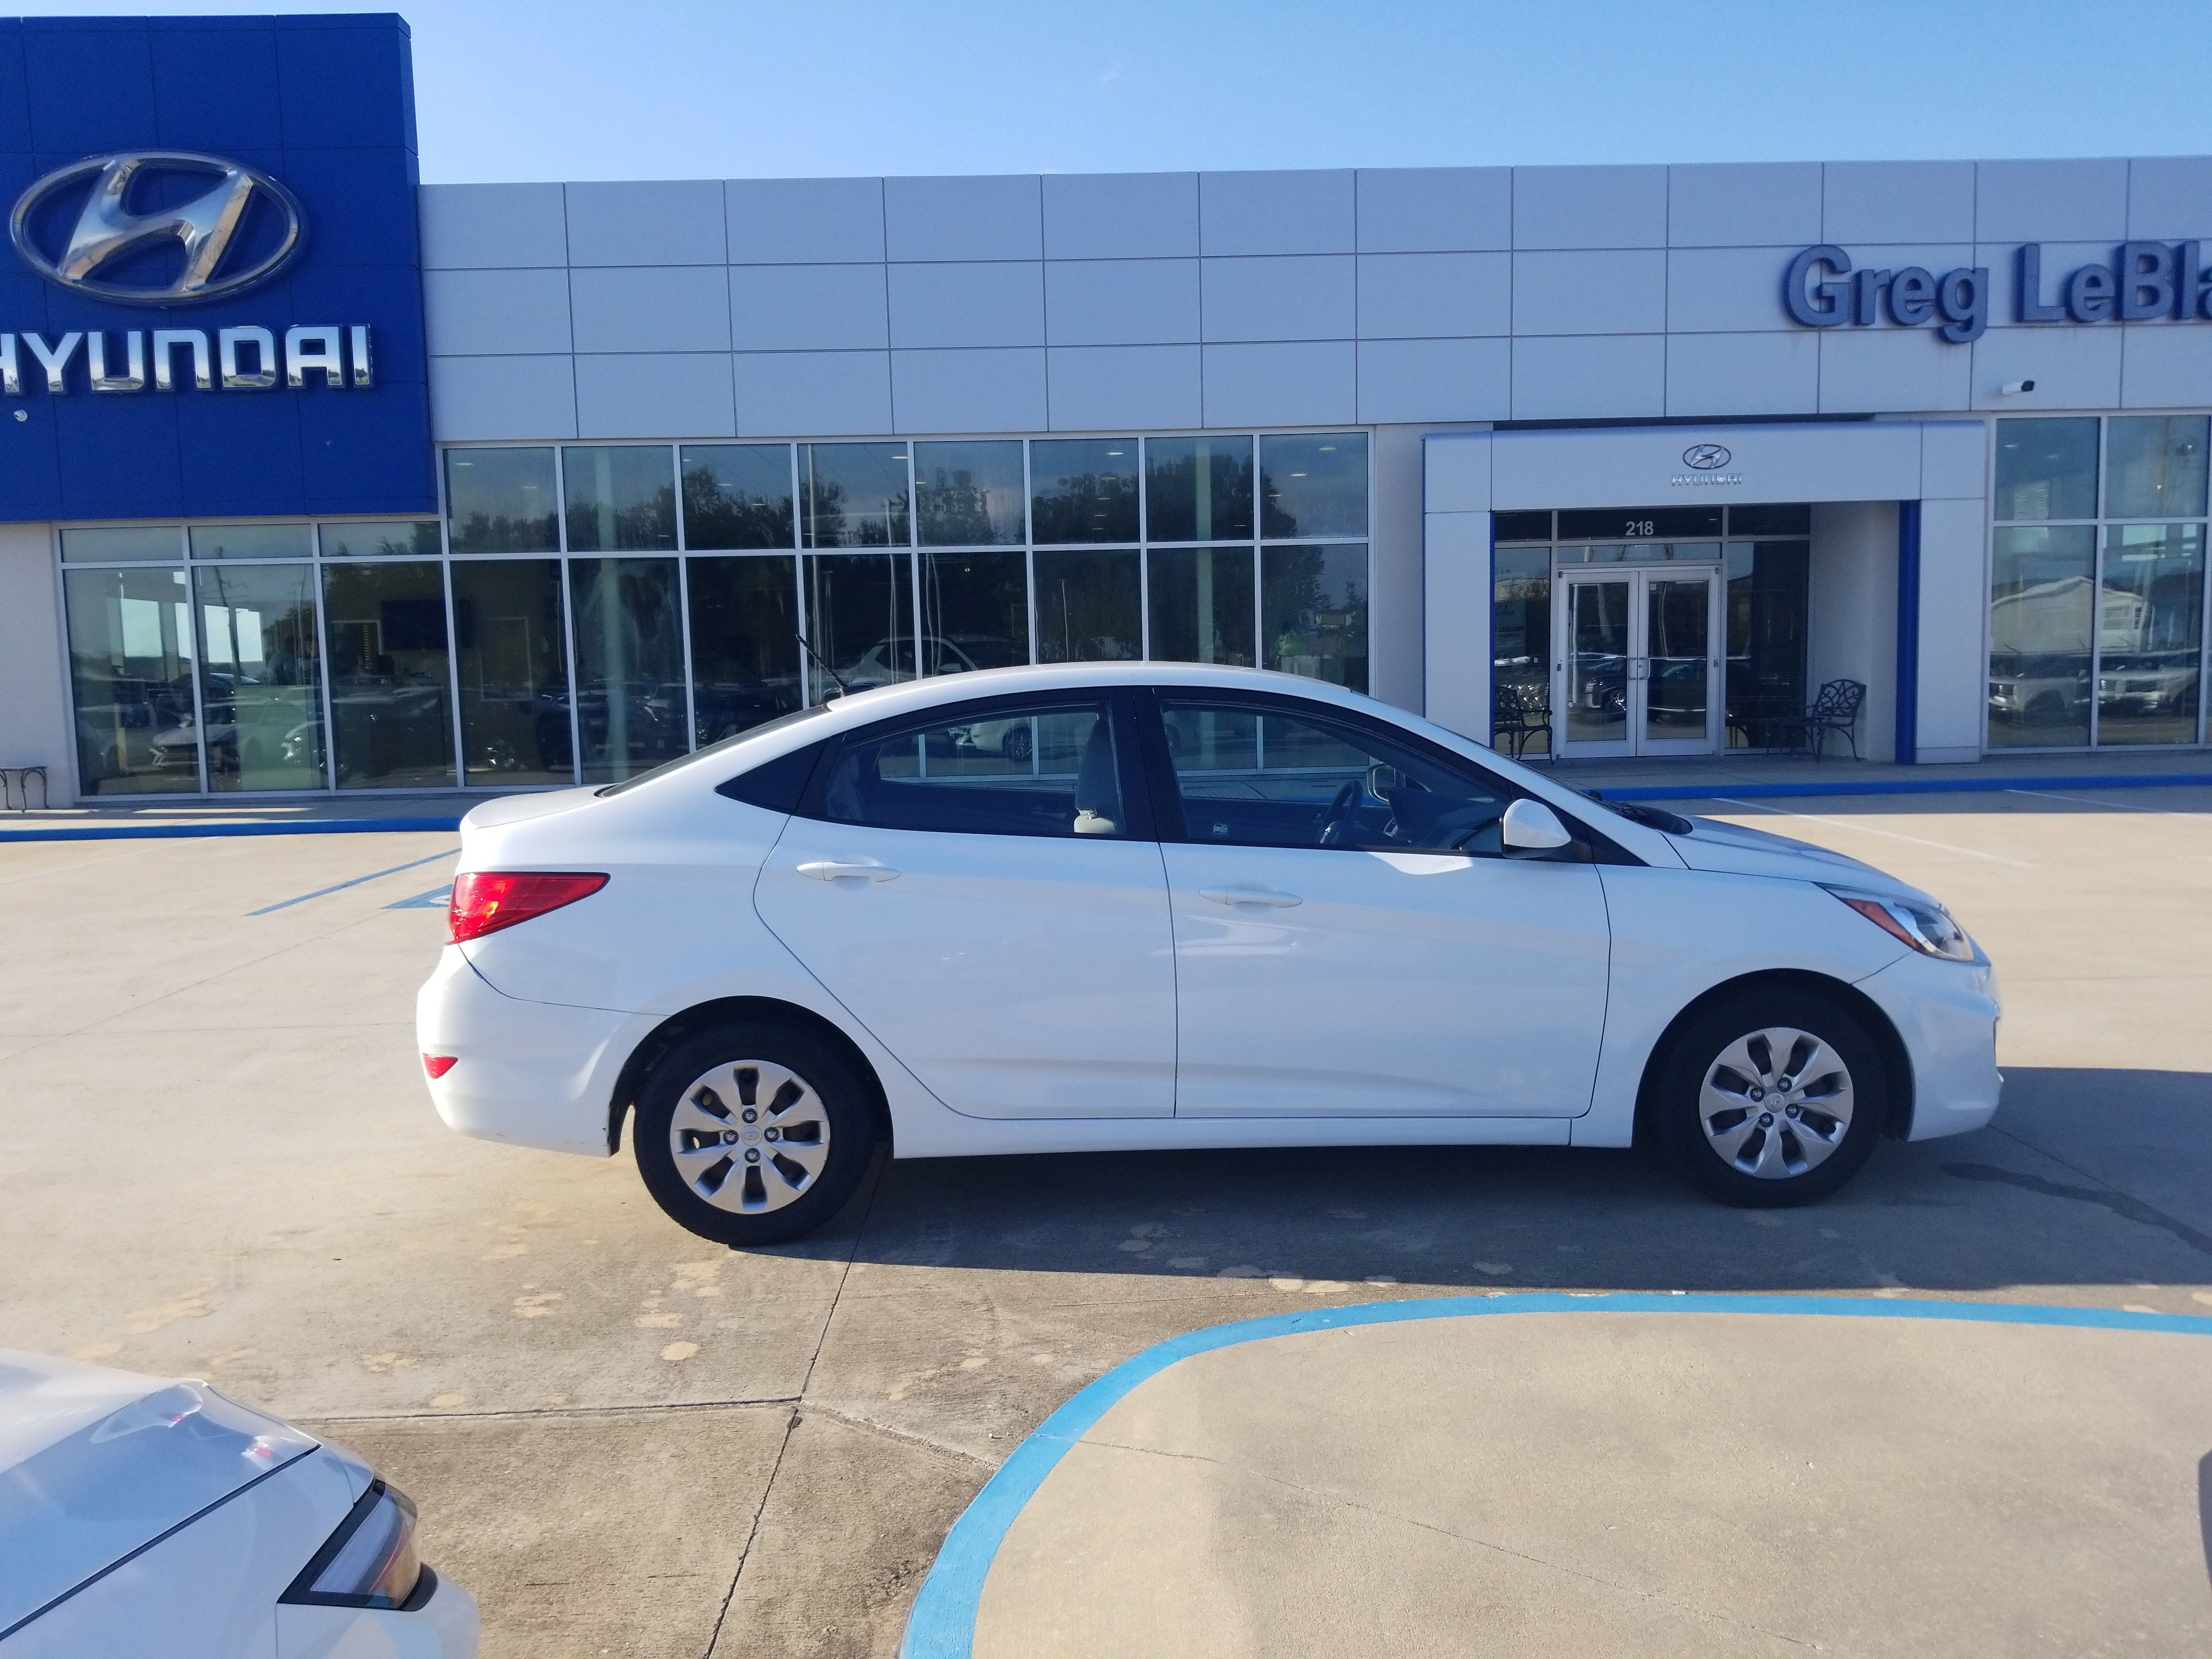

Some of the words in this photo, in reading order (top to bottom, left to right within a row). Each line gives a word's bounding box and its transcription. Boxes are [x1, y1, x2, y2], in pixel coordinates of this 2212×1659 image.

[1785, 244, 1989, 344] Greg
[2016, 240, 2212, 324] LeBl
[1672, 473, 1742, 486] HYUNDAI
[1626, 521, 1654, 536] 218
